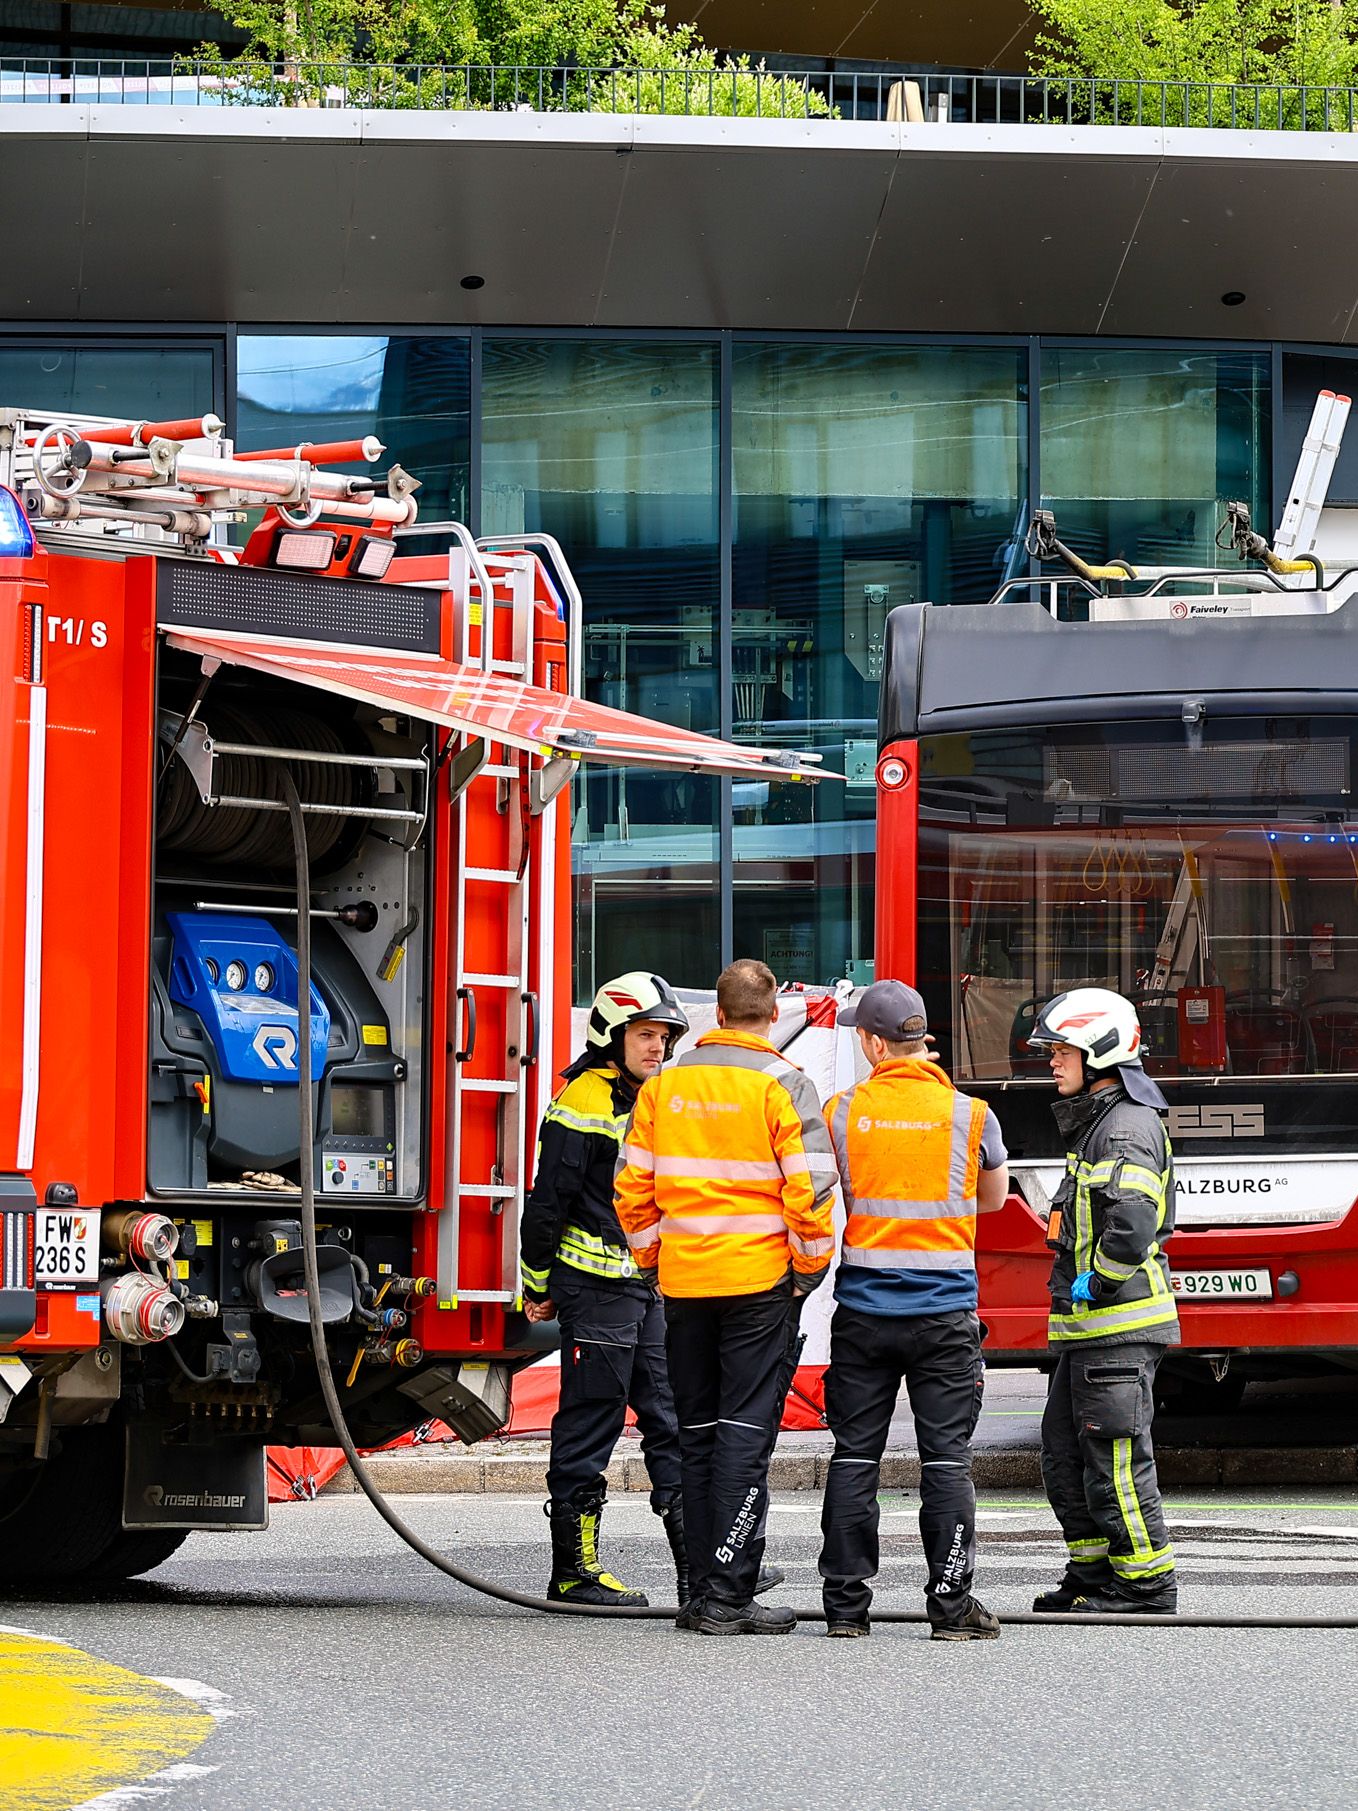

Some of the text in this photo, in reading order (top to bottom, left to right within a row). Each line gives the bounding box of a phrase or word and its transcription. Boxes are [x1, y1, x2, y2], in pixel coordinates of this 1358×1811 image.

[1190, 605, 1228, 614] Faiveley
[90, 621, 108, 648] S
[770, 950, 814, 959] ACHTUNG!
[875, 1119, 932, 1131] SALZBURG
[1164, 1104, 1265, 1138] ESS
[1175, 1178, 1289, 1195] ALZBURG AG
[45, 1216, 72, 1243] FW
[36, 1246, 86, 1274] 236 S
[1184, 1276, 1224, 1293] 929
[164, 1490, 246, 1508] rosenbauer
[726, 1486, 760, 1546] SALZBURG
[734, 1512, 758, 1550] LINIEN
[942, 1523, 965, 1582] SALZBURG
[952, 1549, 967, 1586] LINIEN
